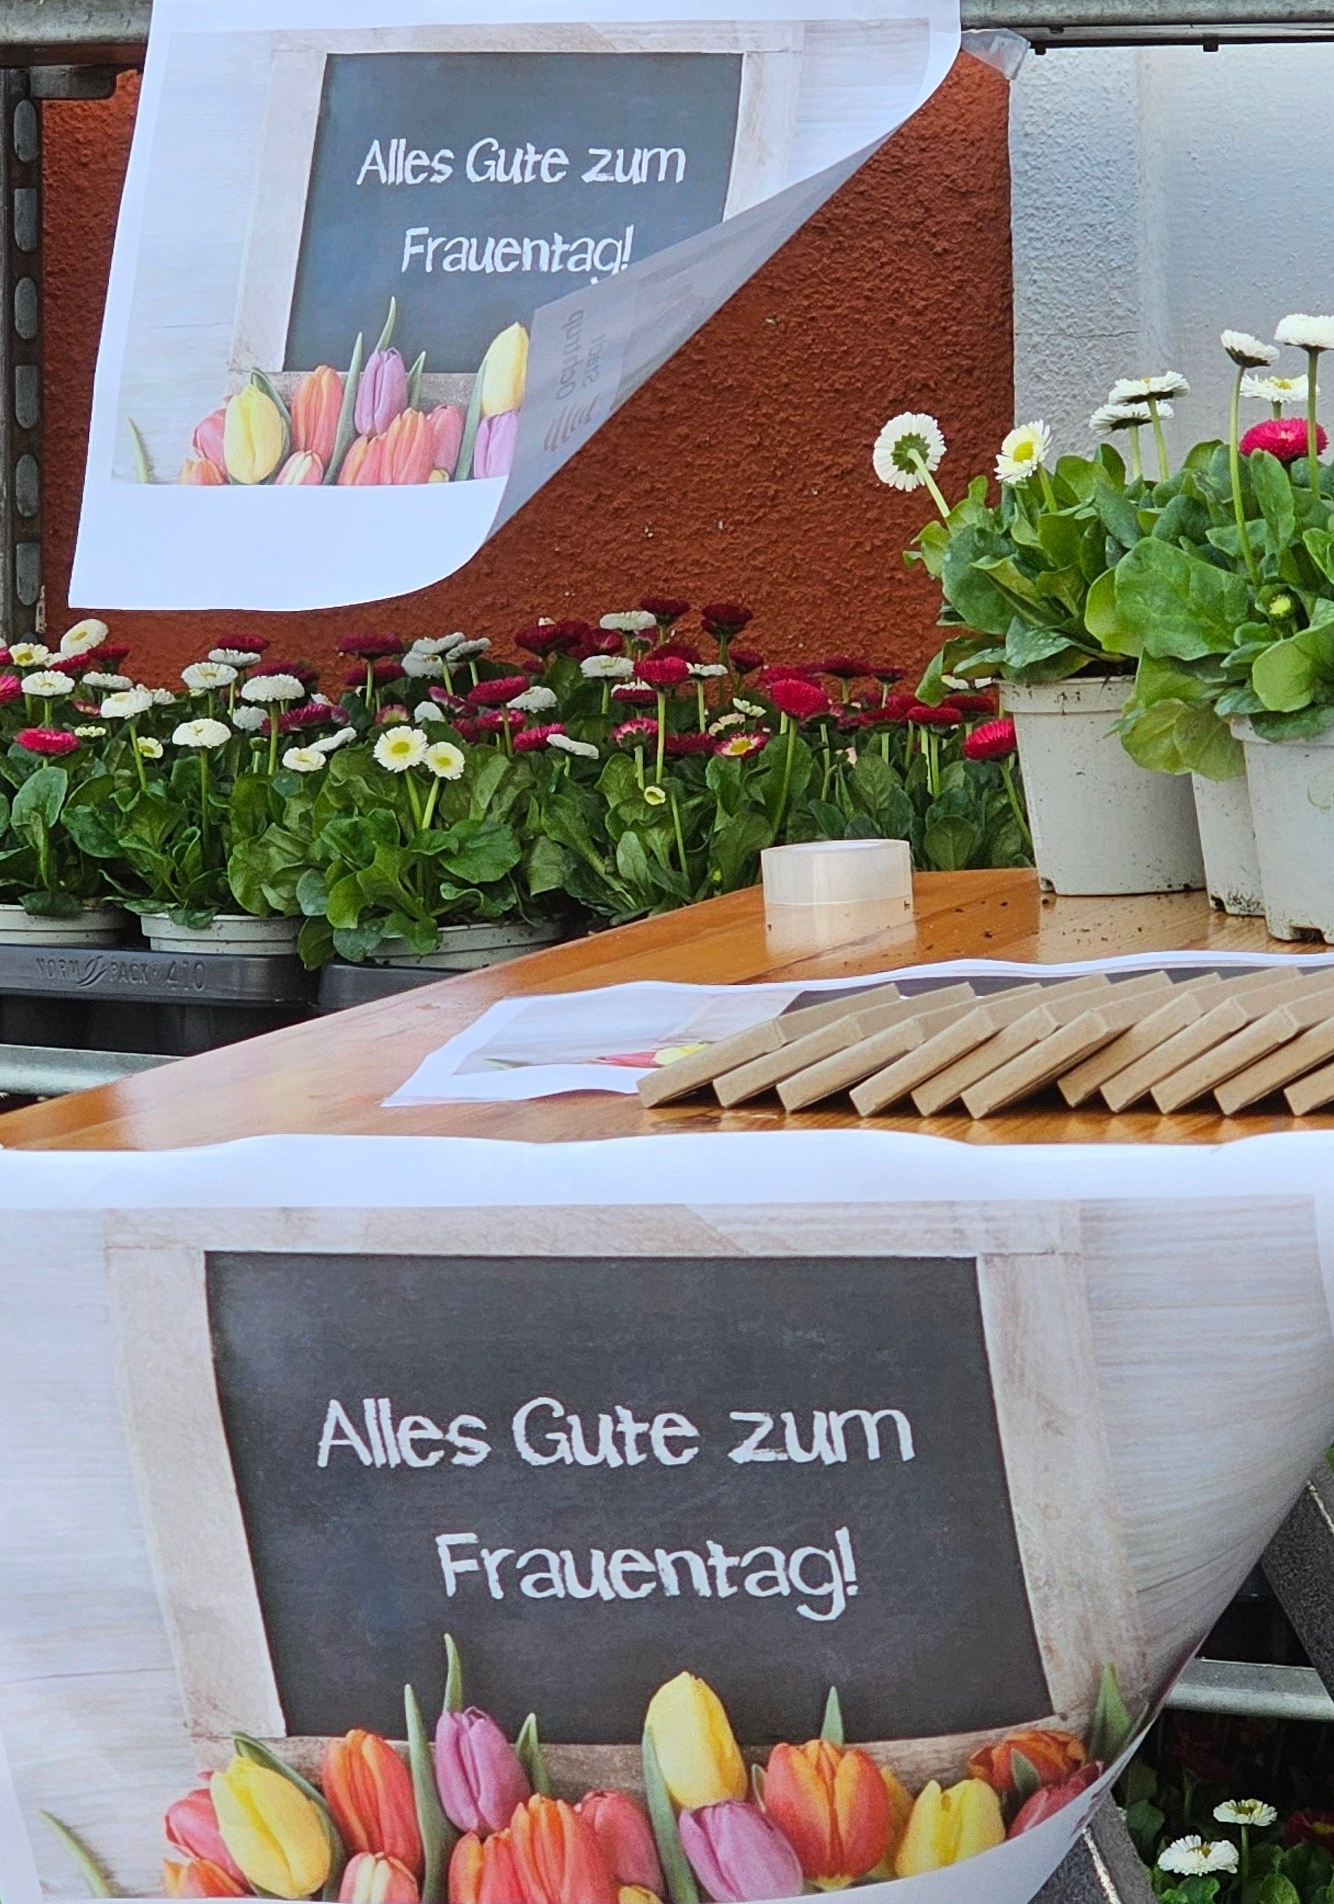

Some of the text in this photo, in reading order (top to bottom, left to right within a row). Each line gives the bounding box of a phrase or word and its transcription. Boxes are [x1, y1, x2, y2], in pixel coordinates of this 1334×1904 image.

[355, 136, 687, 187] Alles Gute zum
[401, 224, 634, 285] Frauentag!
[317, 1395, 916, 1469] Alles Gute zum
[434, 1525, 860, 1622] Frauentag!
